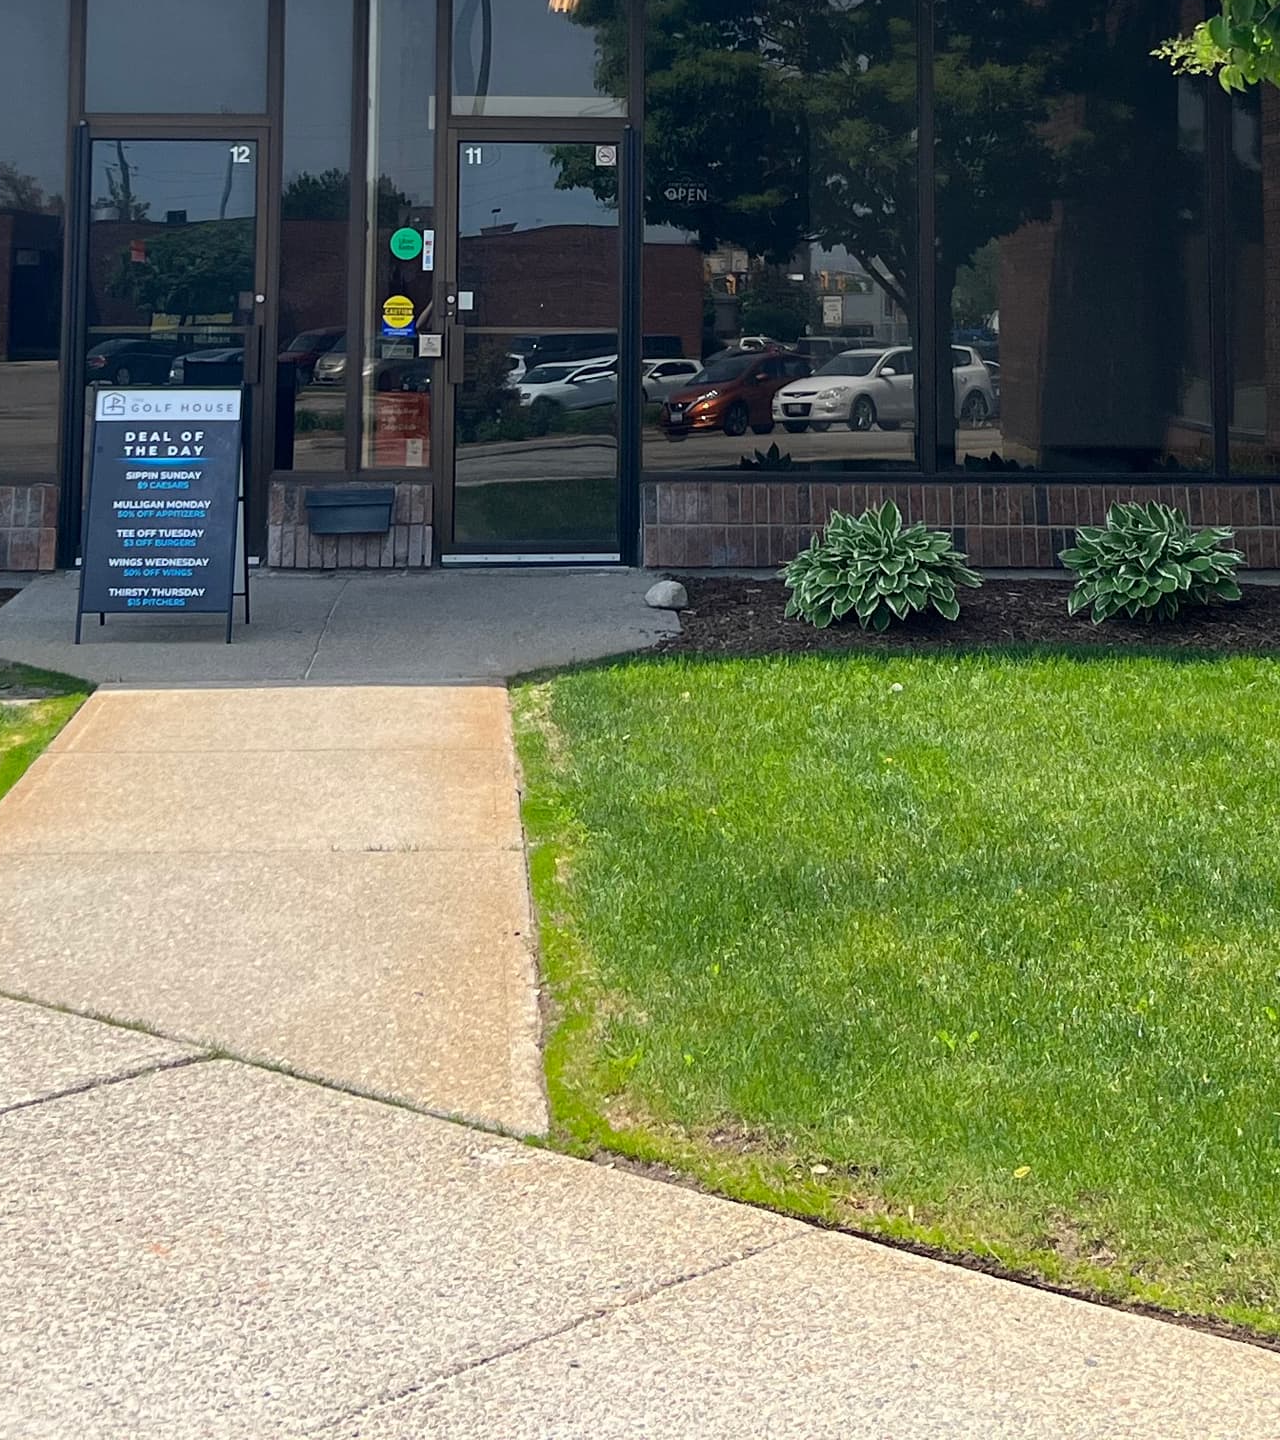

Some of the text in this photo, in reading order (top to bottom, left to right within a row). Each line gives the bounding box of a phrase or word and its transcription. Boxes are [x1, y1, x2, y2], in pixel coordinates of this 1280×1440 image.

[229, 145, 251, 163] 12
[465, 147, 482, 164] 11
[665, 187, 708, 201] OPEN
[131, 403, 233, 413] GOLF HOUSE
[125, 431, 205, 442] DEAL OF
[124, 445, 205, 457] THE DAY
[125, 471, 202, 481] SIPPIN SUNDAY
[150, 481, 190, 490] CAESARS
[113, 500, 212, 509] MULLIGAN MONDAY
[136, 510, 154, 518] OFF
[116, 529, 205, 538] TEE OFF TUESDAY
[135, 539, 153, 547] OFF
[154, 539, 197, 547] BURGERS
[108, 558, 210, 567] WINGS WEDNESDAY
[123, 568, 193, 577] 50% OFF WINGS
[108, 587, 206, 597] THIRSTY THURSDAY
[141, 598, 186, 607] PITCHERS
